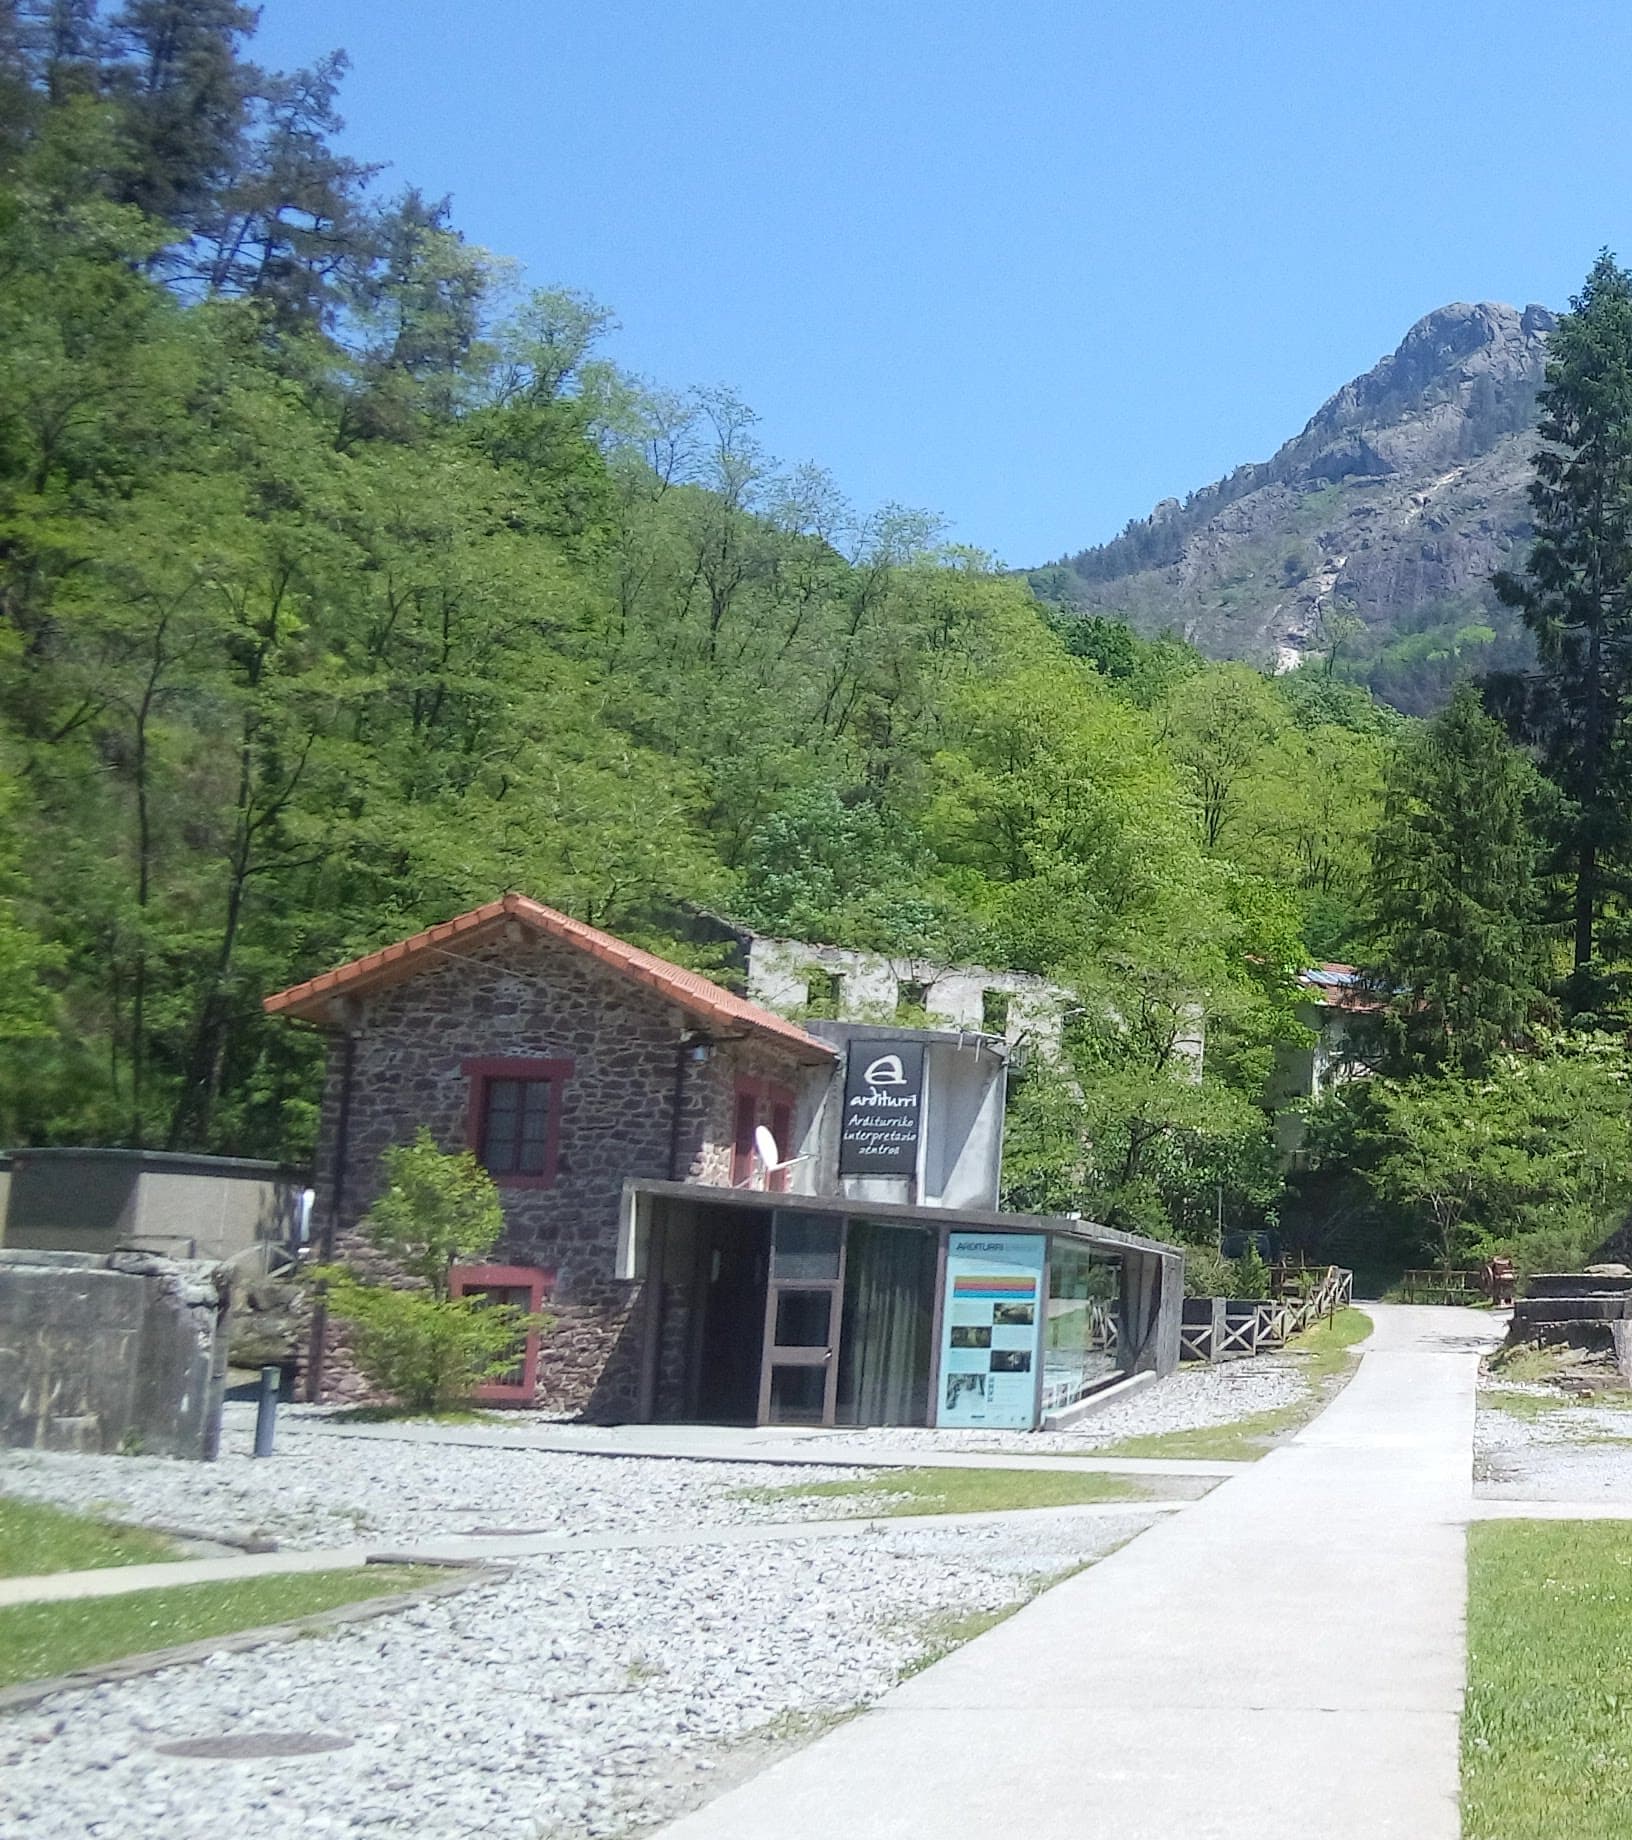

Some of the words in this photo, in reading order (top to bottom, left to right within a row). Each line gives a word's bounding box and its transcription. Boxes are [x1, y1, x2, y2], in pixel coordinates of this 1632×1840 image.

[850, 1086, 917, 1107] arditurri
[848, 1113, 914, 1128] Arditurriko
[843, 1128, 917, 1146] interpretazio
